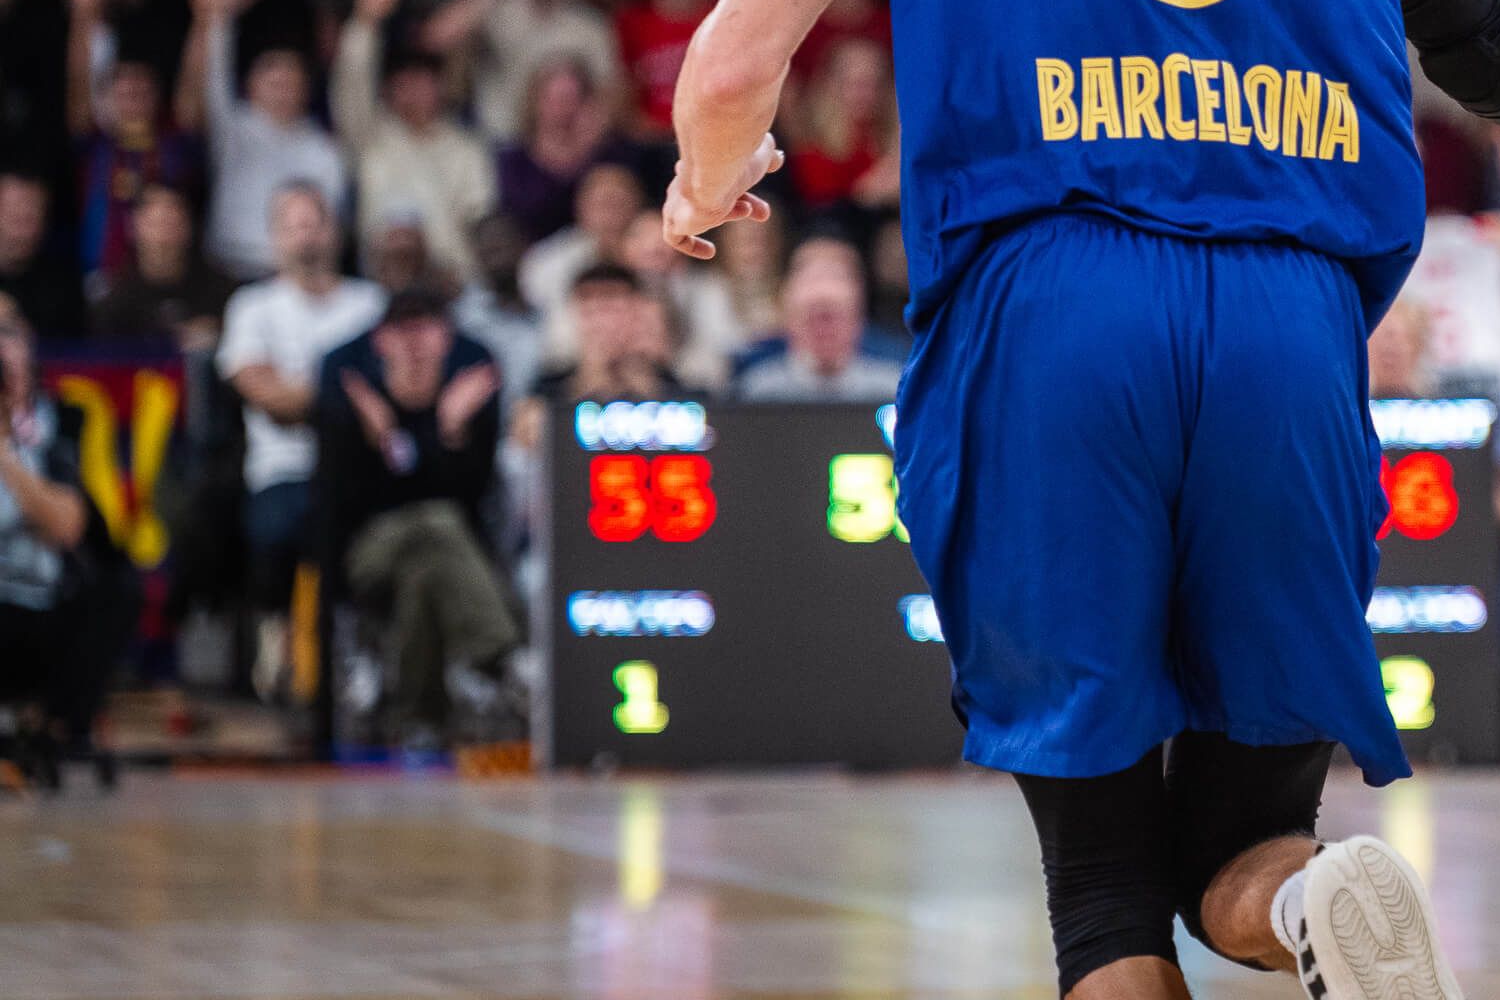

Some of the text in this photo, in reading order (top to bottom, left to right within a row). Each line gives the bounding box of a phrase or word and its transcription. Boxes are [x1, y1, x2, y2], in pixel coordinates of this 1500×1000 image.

[1035, 53, 1360, 163] BARCELONA
[589, 454, 718, 542] 55
[612, 659, 670, 734] 1
